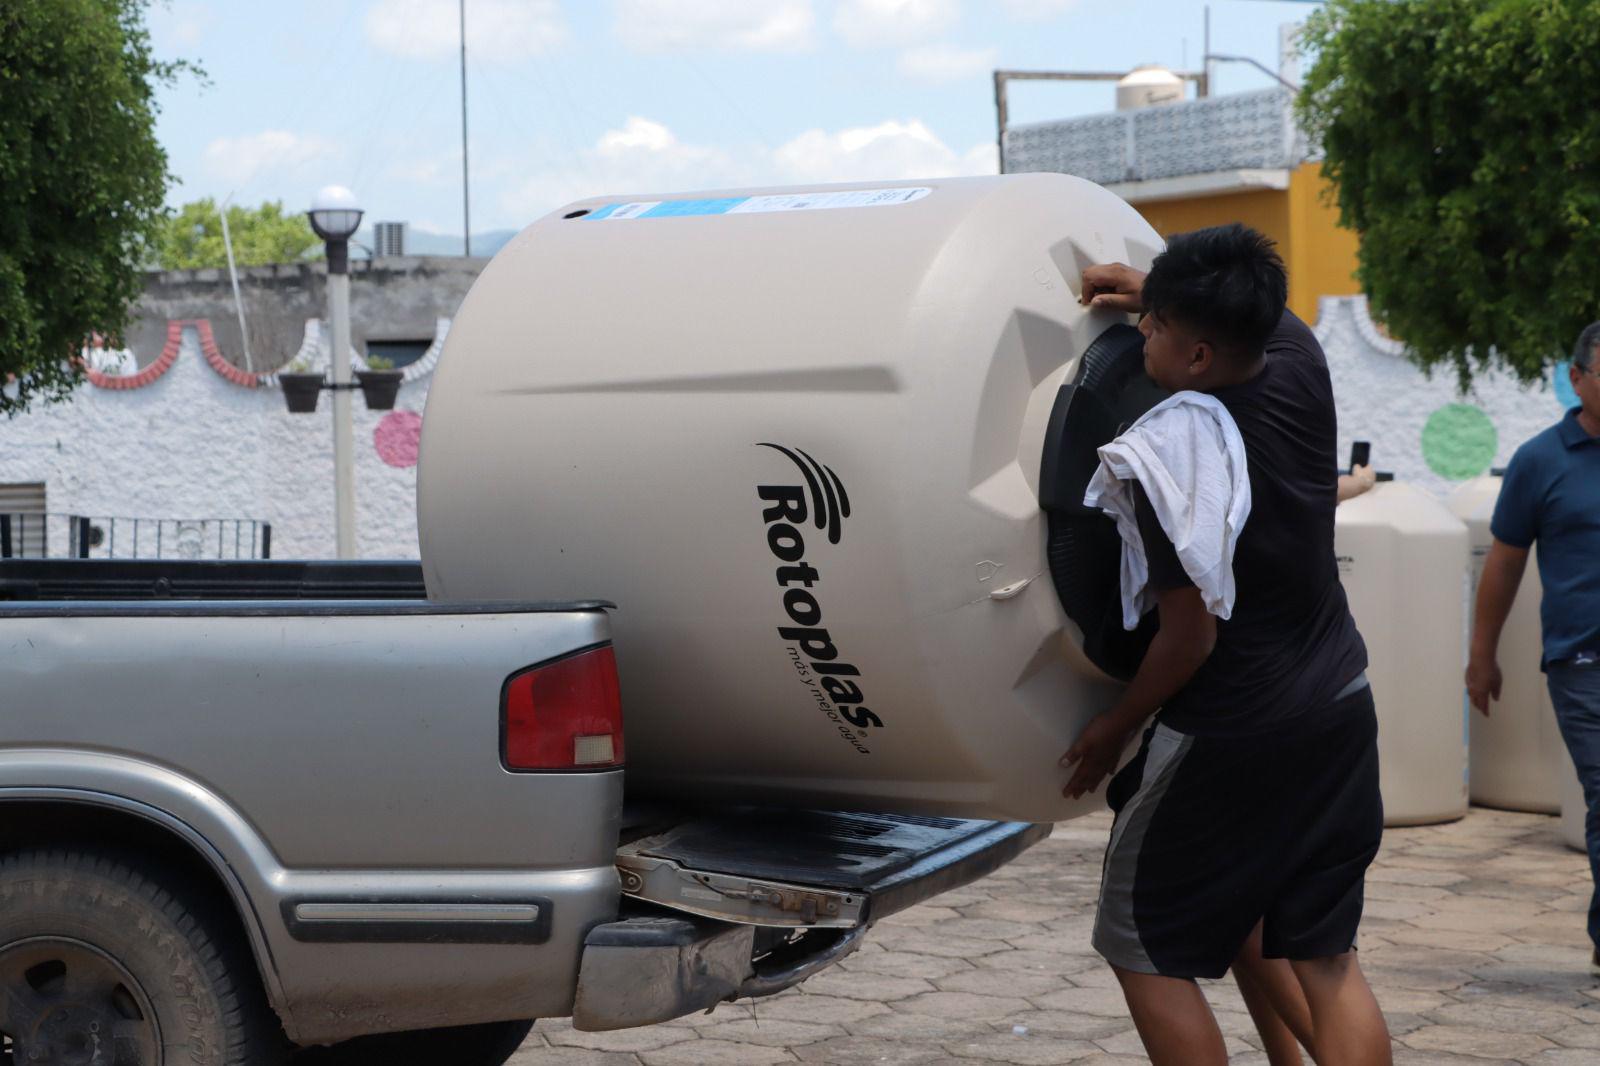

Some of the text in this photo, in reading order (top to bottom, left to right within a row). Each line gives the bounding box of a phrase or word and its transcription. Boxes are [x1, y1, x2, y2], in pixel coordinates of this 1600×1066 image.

[757, 485, 884, 729] Rotoplas
[786, 647, 871, 754] más y mejor agua
